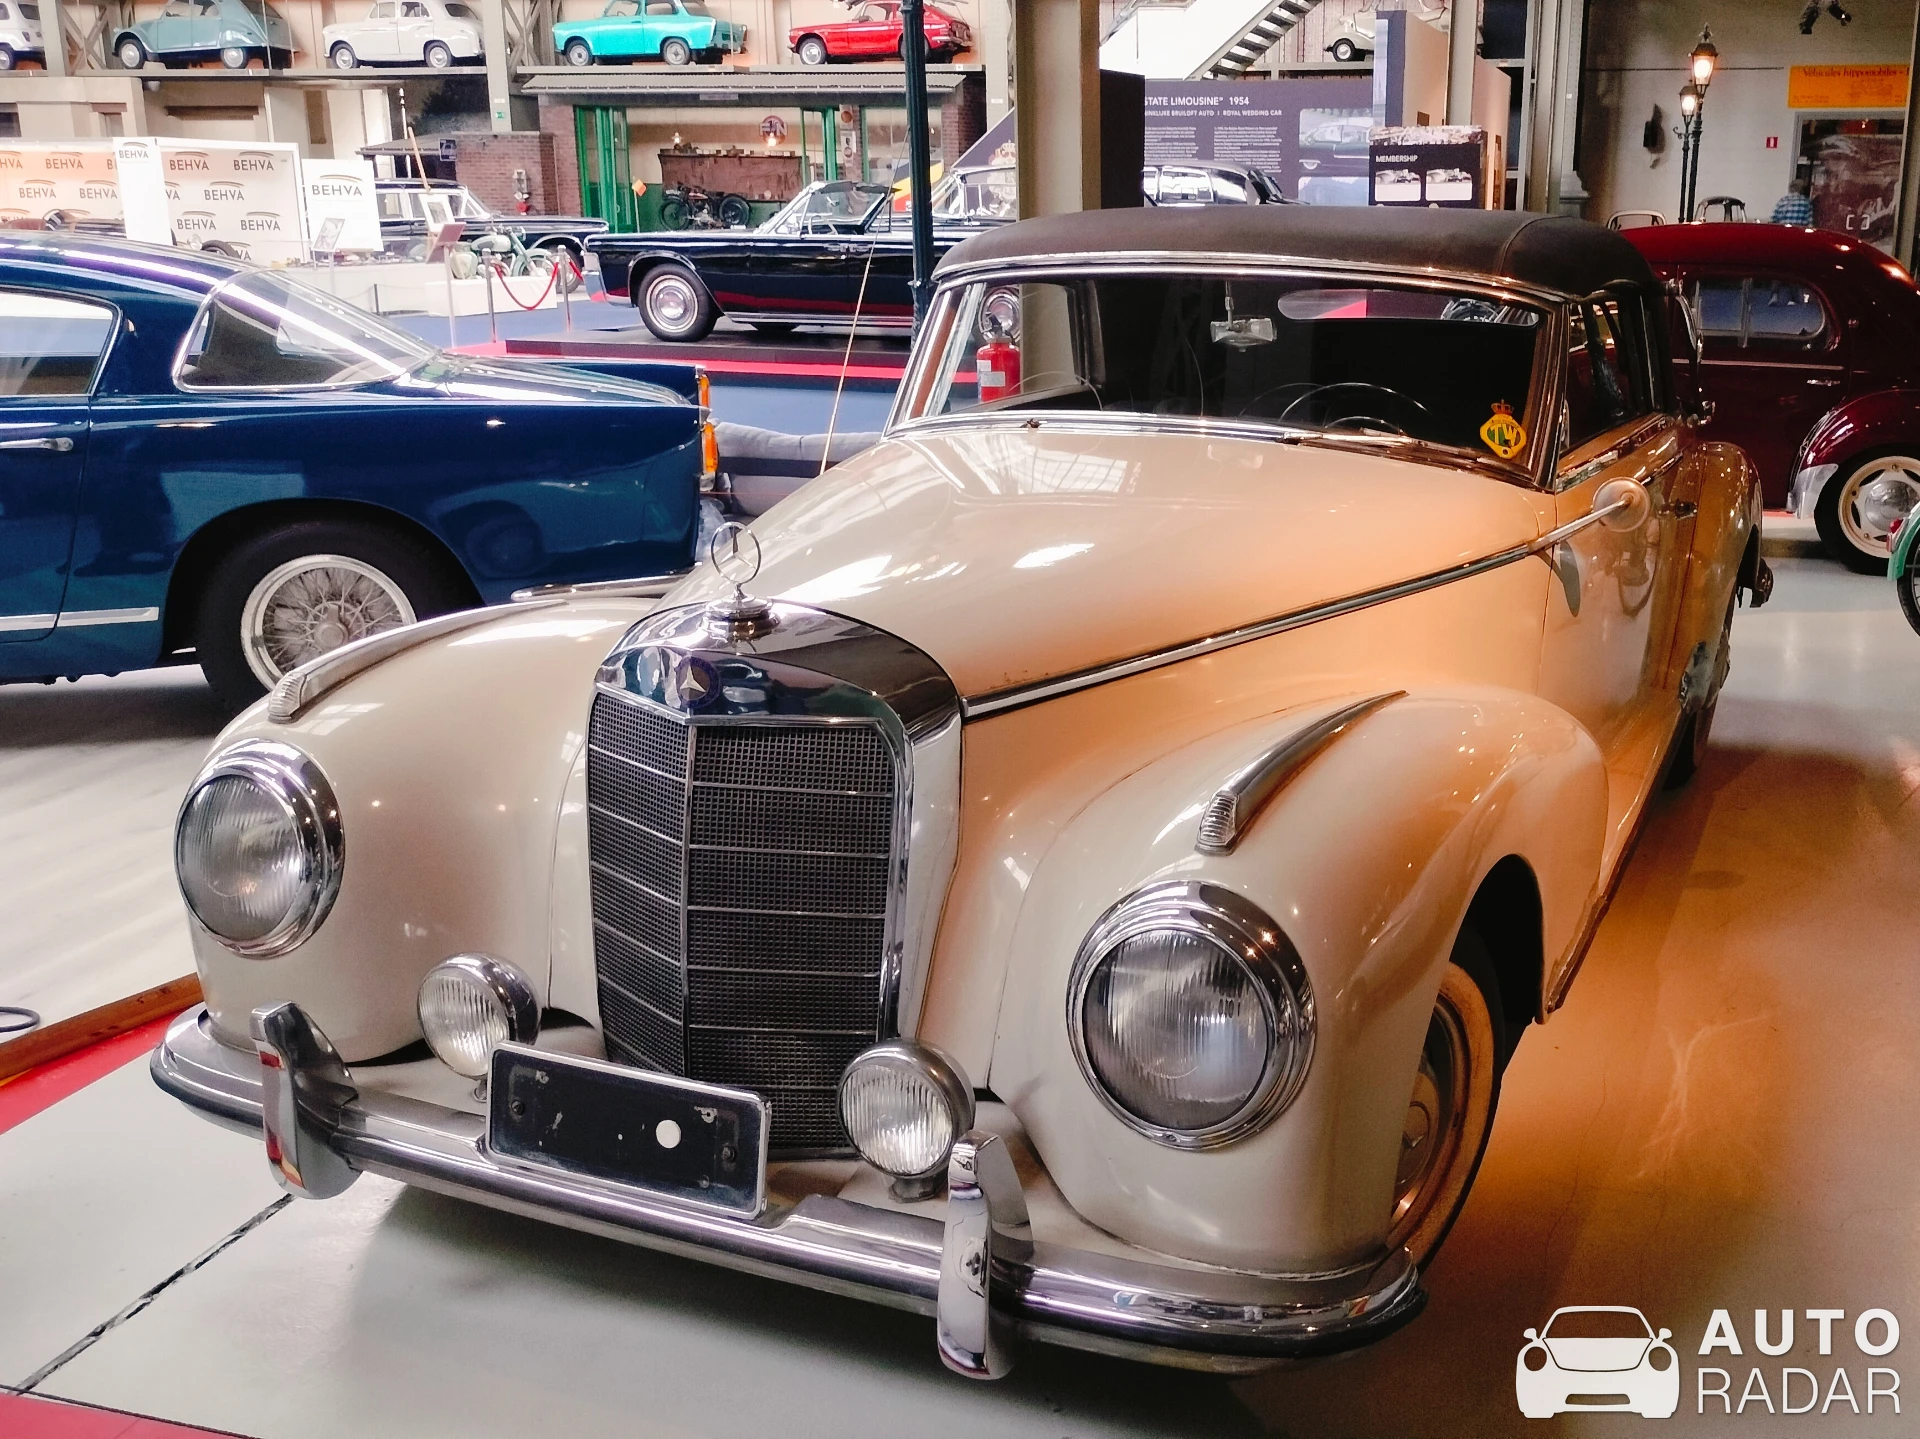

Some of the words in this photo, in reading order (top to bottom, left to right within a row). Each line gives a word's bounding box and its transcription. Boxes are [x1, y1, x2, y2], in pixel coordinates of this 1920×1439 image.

[1229, 96, 1250, 106] 1954
[118, 150, 149, 159] BEHVA
[1375, 155, 1418, 163] MEMBERSHIP
[45, 158, 84, 170] BEHVA
[169, 159, 210, 171] BEHVA
[233, 159, 275, 171] BEHVA
[19, 187, 57, 199] BEHVA
[79, 187, 118, 199] BEHVA
[203, 189, 245, 201] BEHVA
[311, 184, 363, 196] BEHVA
[176, 218, 217, 230] BEHVA
[240, 219, 281, 231] BEHVA
